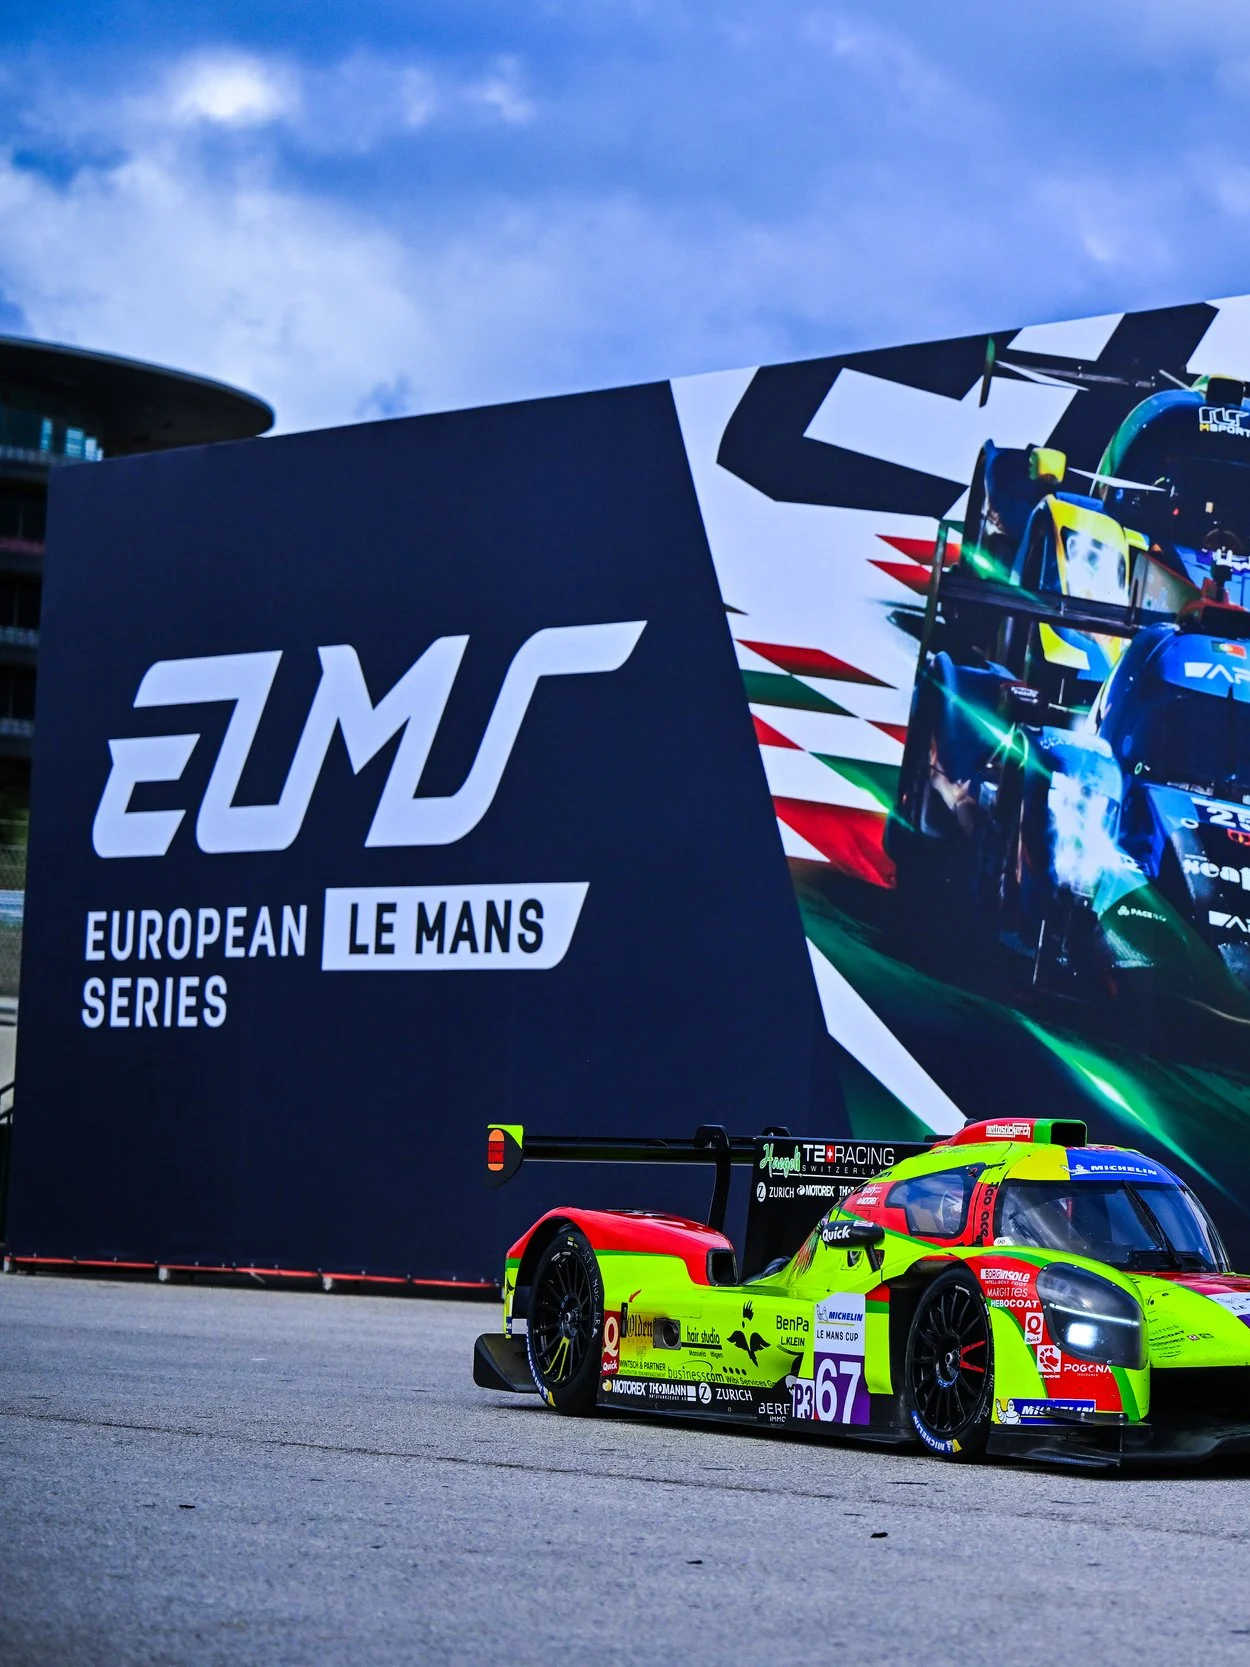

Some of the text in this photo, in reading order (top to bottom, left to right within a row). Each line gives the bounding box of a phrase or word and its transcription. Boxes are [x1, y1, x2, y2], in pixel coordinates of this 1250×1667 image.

[92, 620, 648, 858] ELMS
[86, 899, 545, 961] EUROPEAN LE MANS
[82, 975, 228, 1029] SERIES
[834, 1145, 895, 1165] RACING
[802, 1164, 887, 1176] SWITZERLA
[1090, 1164, 1158, 1176] MICHELIN
[768, 1186, 795, 1198] ZURICH
[804, 1184, 835, 1197] MOTOREX
[822, 1225, 851, 1242] Quick
[990, 1299, 1039, 1309] HEBOCOAT
[776, 1315, 809, 1332] BenPa
[828, 1311, 863, 1322] MICHELIN
[1027, 1315, 1042, 1336] Q
[604, 1316, 619, 1358] Q
[686, 1325, 720, 1344] hair studio
[816, 1330, 859, 1342] LE MANS CUP
[602, 1360, 618, 1372] Quick
[1063, 1363, 1112, 1374] POGONA
[612, 1379, 646, 1396] MOTOREX
[648, 1382, 687, 1396] THOMANN
[715, 1388, 753, 1401] ZURICH
[815, 1358, 862, 1424] 67
[912, 1415, 946, 1451] MICHELIN
